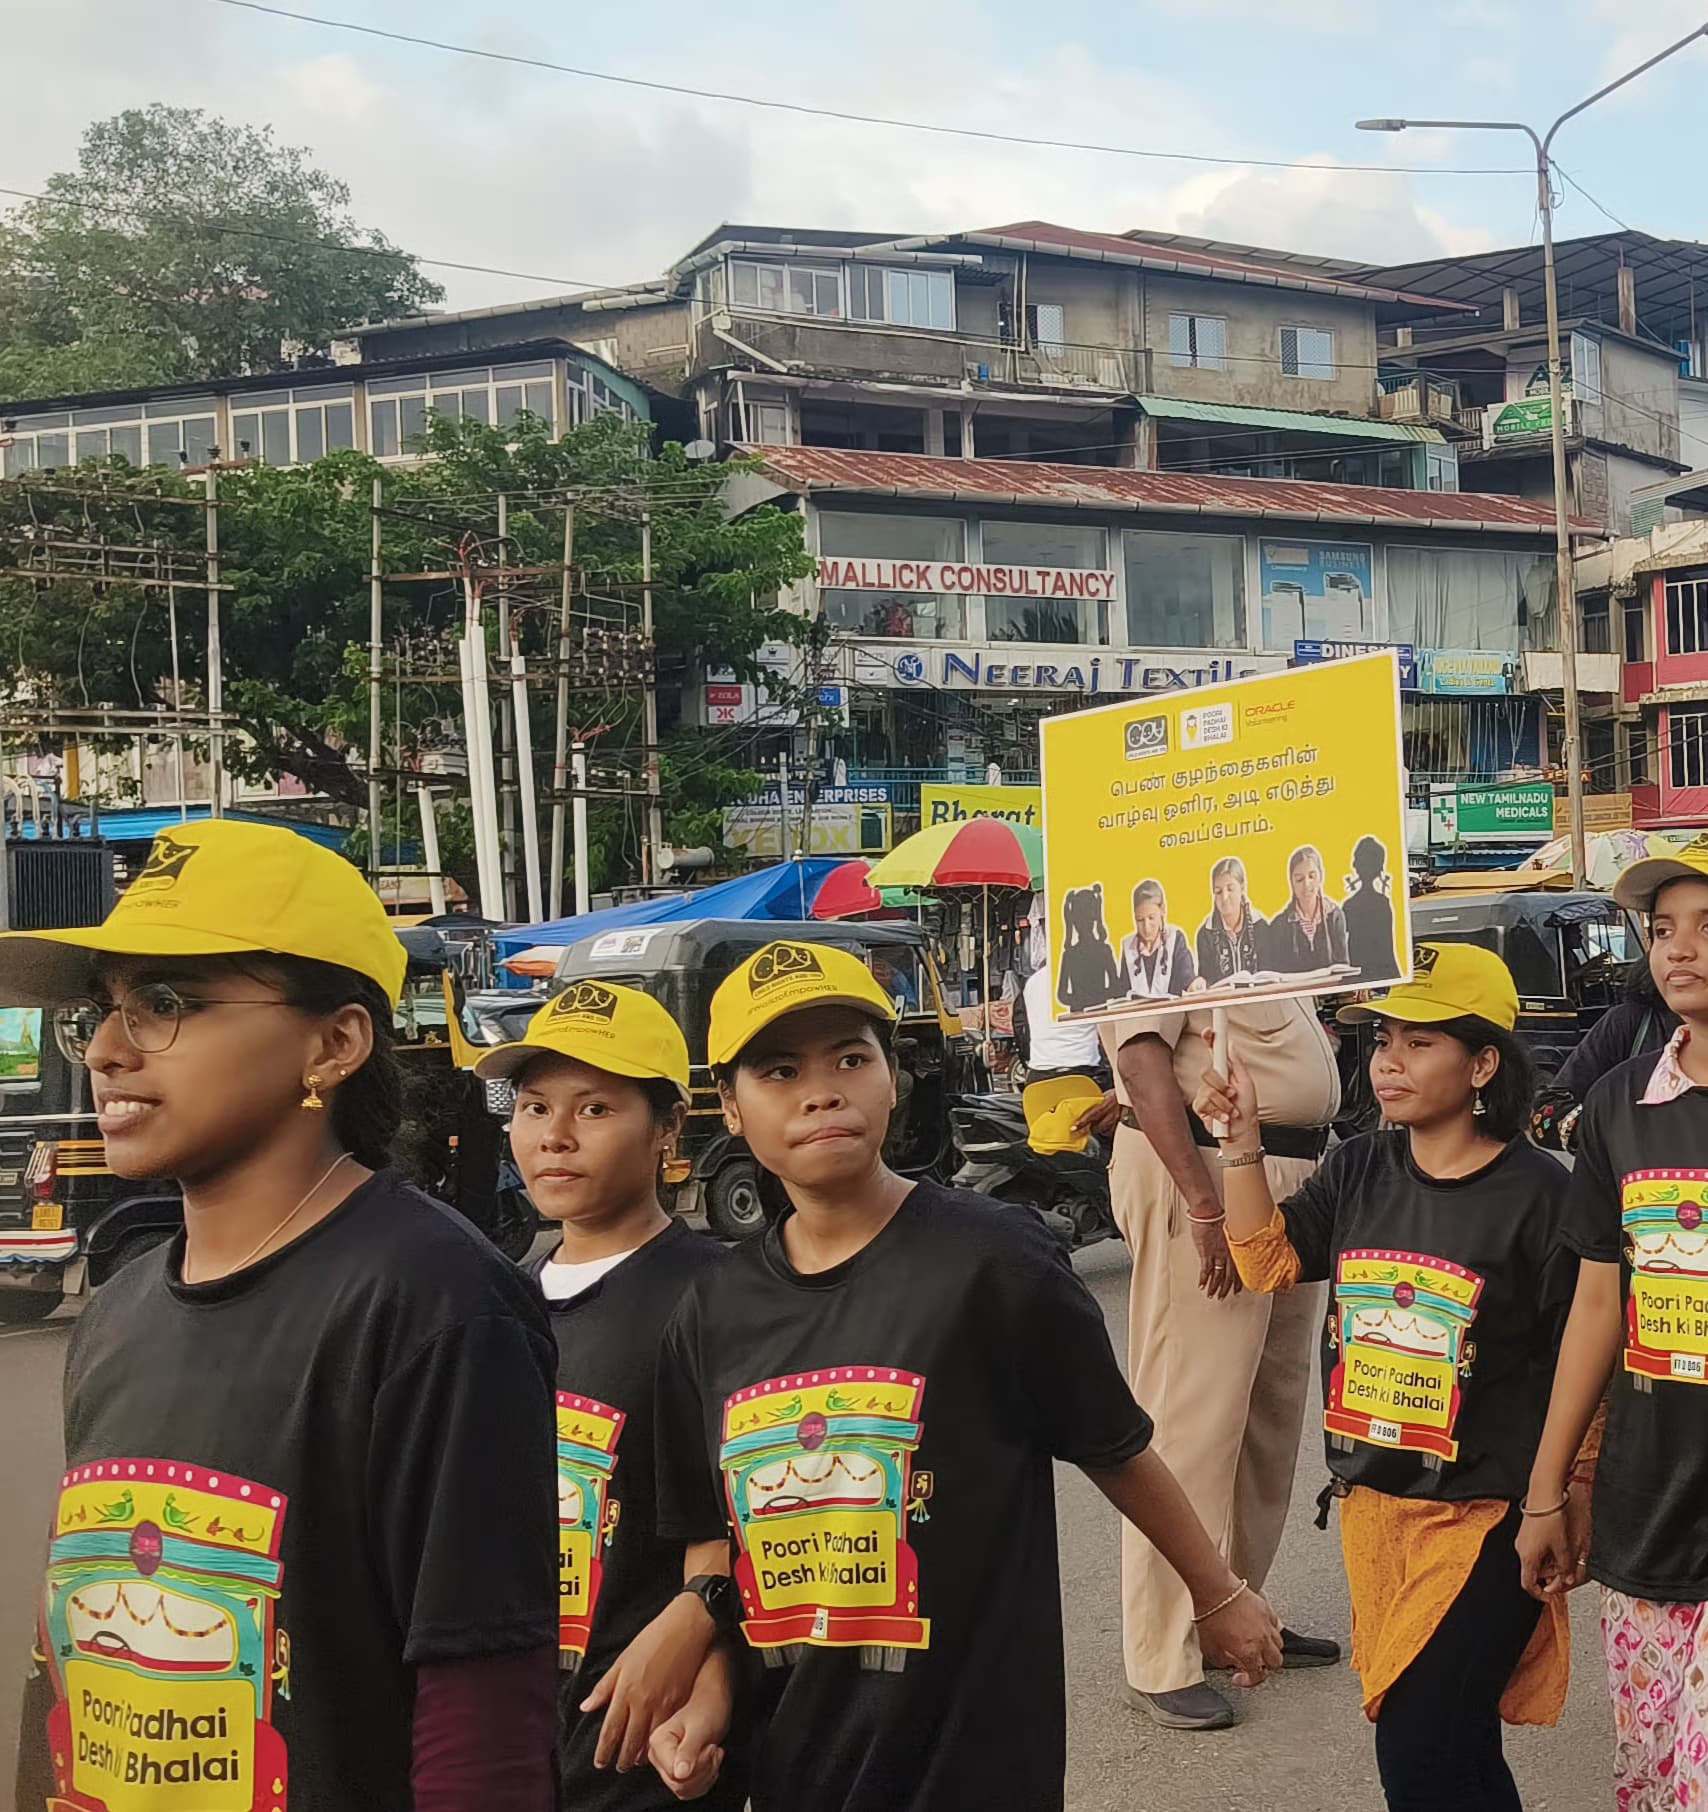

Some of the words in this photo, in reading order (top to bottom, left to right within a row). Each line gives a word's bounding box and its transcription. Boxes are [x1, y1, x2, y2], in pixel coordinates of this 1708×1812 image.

[820, 560, 932, 590] MALLICK
[940, 565, 1115, 598] CONSULTANCY
[1245, 699, 1297, 718] ORACLE
[787, 788, 888, 804] ENERPRISES
[1110, 771, 1167, 799] பெண்
[1461, 793, 1485, 805] NEW
[1487, 791, 1549, 805] TAMILNADU
[1495, 806, 1549, 819] MEDICALS
[1641, 1290, 1682, 1312] Poori
[1640, 1312, 1671, 1335] Desh
[1676, 1315, 1691, 1335] ki
[1353, 1358, 1387, 1381] Poori
[1388, 1367, 1442, 1390] Padhai
[1347, 1379, 1378, 1402] Desh
[1379, 1385, 1390, 1403] ki
[1392, 1388, 1446, 1412] Bhalai
[761, 1532, 820, 1560] Poori
[761, 1563, 816, 1590] Desh
[82, 1689, 126, 1729] Poori
[122, 1703, 228, 1741] Padhai
[79, 1731, 113, 1772] Desh
[124, 1749, 239, 1785] Bhalai
